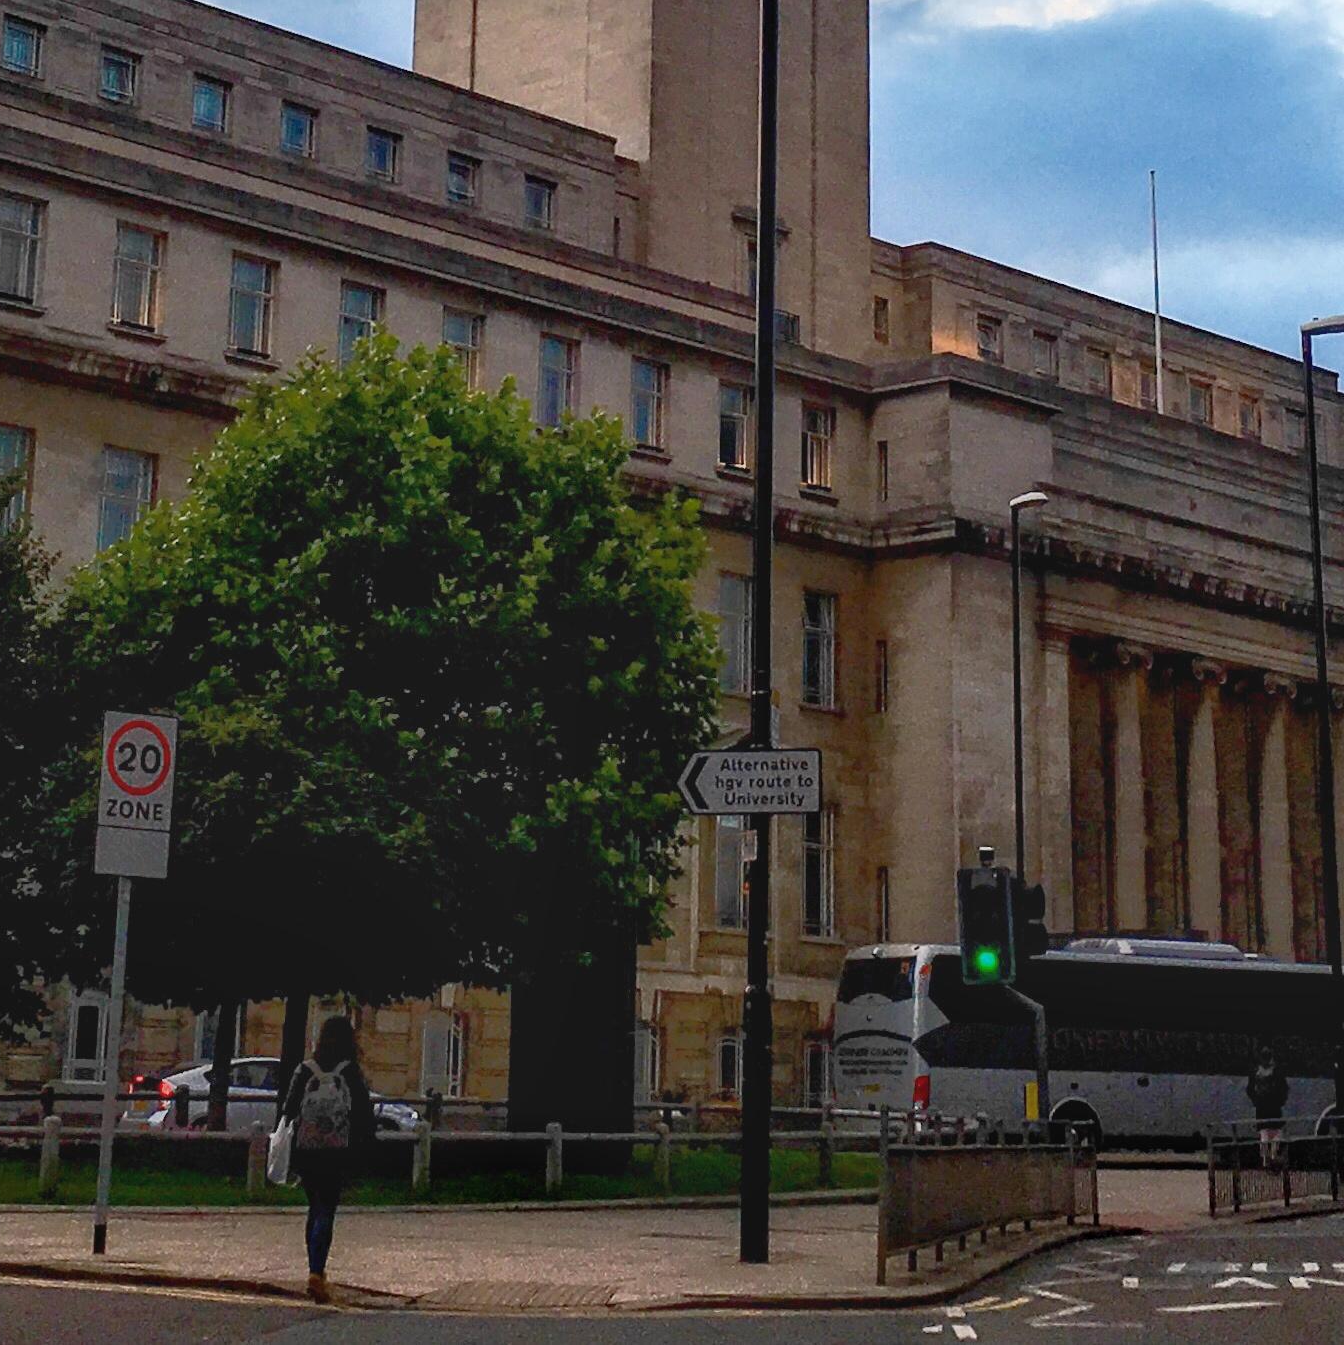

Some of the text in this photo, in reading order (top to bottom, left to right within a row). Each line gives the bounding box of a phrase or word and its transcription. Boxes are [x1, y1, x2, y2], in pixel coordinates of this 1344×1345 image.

[118, 741, 161, 774] 20
[720, 757, 809, 772] Alternative
[714, 774, 814, 790] hgv route to
[724, 792, 805, 807] University
[106, 798, 163, 821] ZONE
